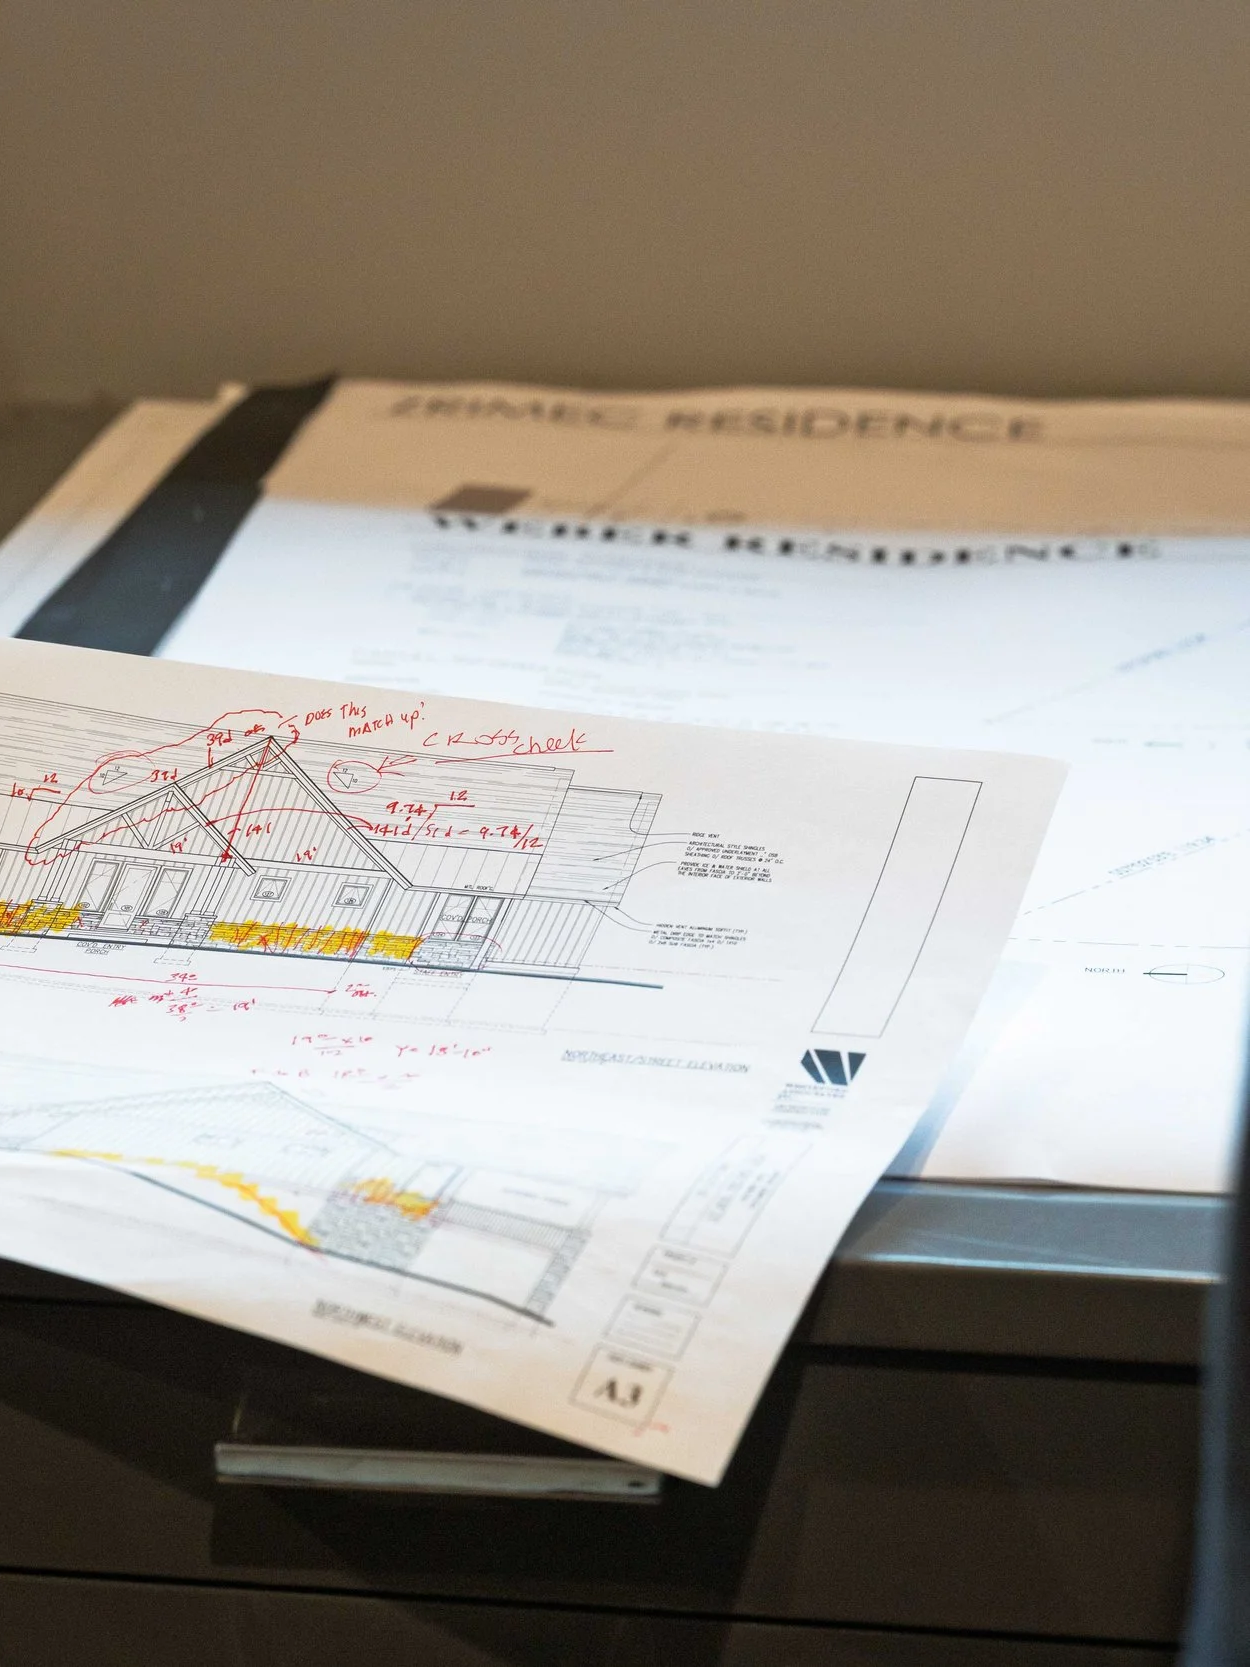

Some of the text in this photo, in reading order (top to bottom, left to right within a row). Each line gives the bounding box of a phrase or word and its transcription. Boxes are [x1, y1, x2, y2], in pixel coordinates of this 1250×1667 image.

[664, 406, 1046, 443] RESIDENCE
[724, 531, 1161, 566] RESIDENCE
[686, 1058, 751, 1074] ELEVATION
[594, 1376, 644, 1408] A3
